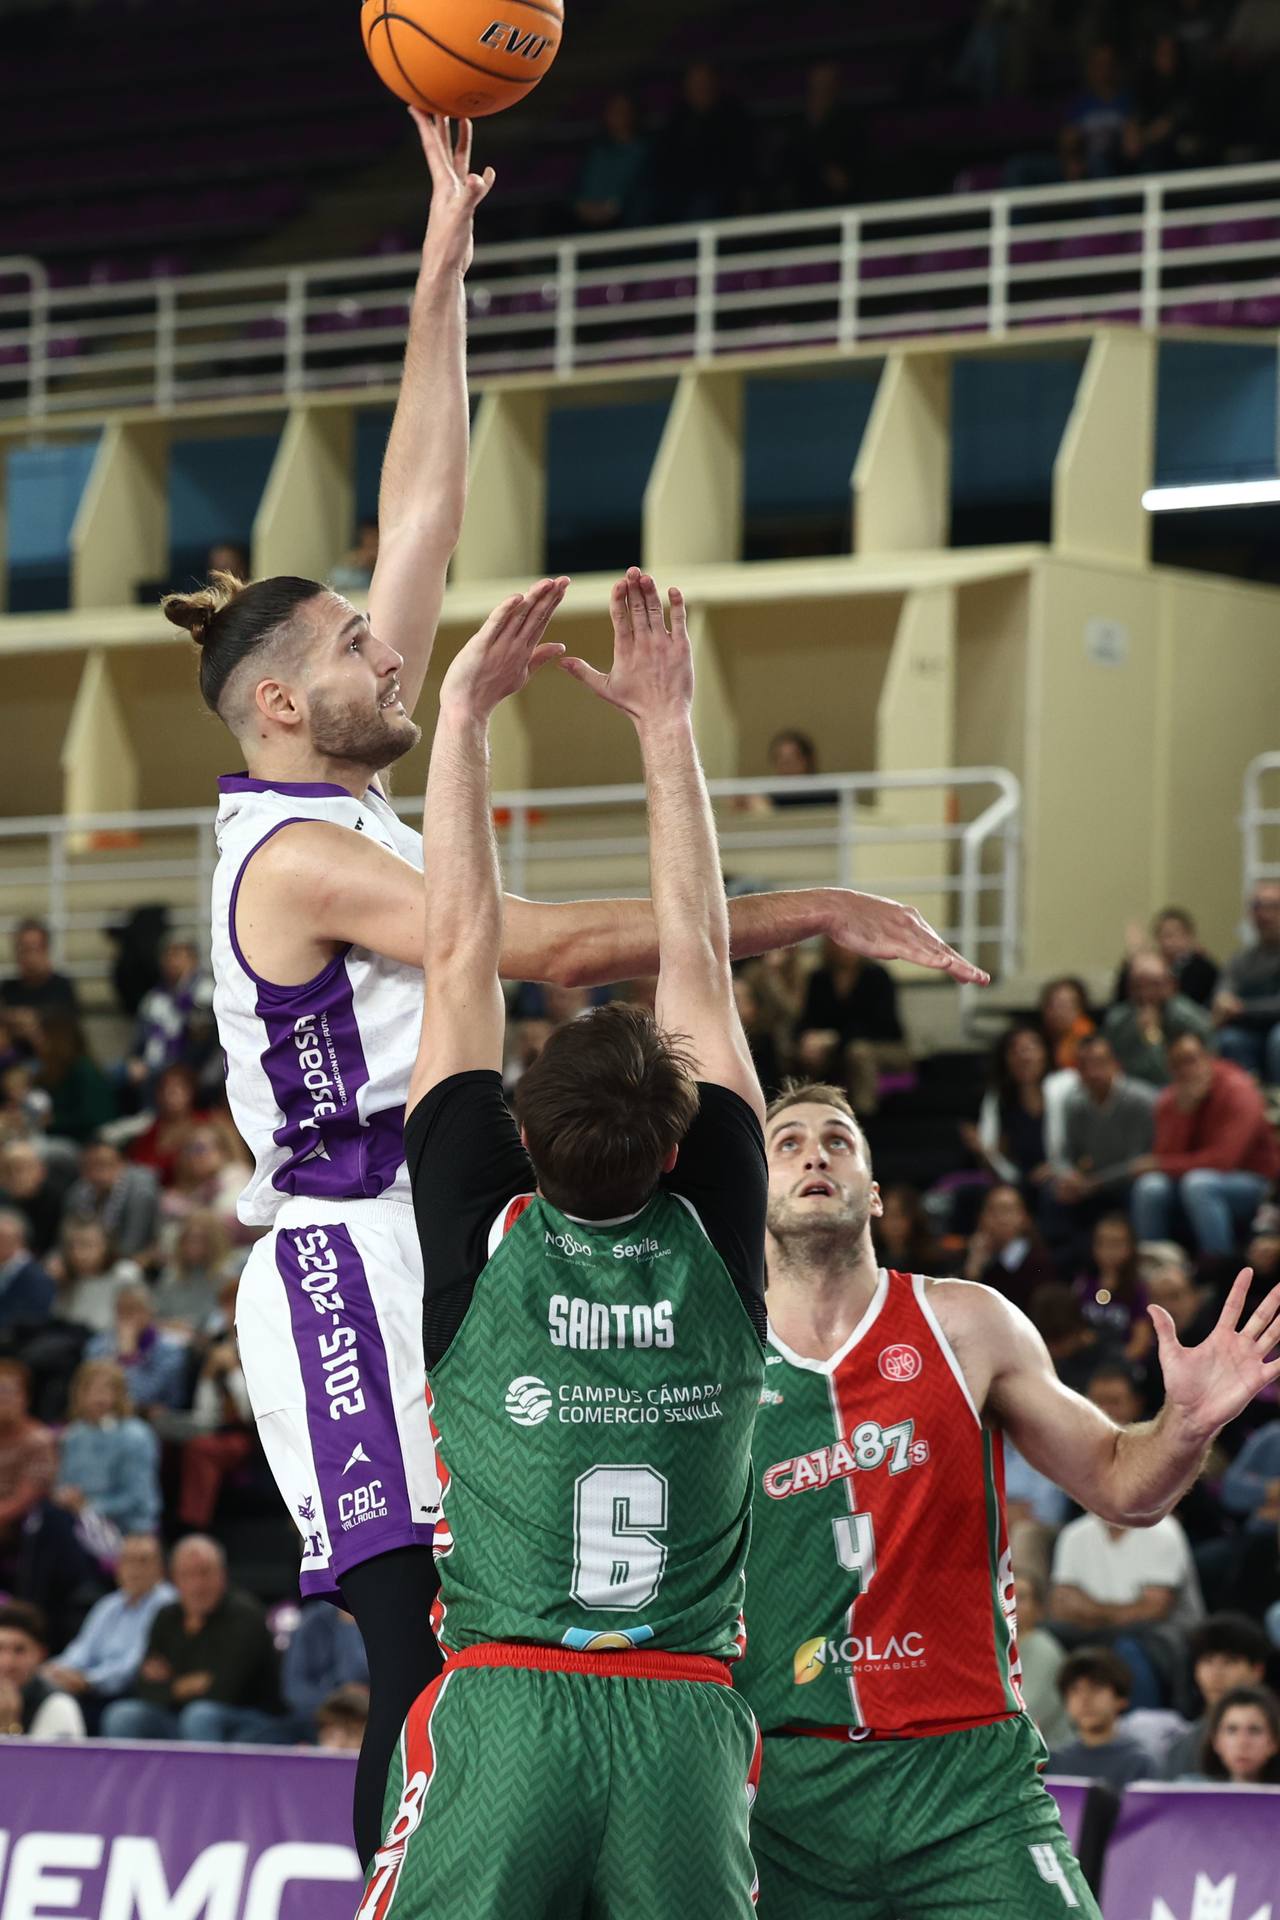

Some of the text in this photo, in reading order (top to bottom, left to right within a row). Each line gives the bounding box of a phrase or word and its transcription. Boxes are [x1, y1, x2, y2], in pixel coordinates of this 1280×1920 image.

[293, 1228, 367, 1421] 2015-2025
[548, 1294, 675, 1350] SANTOS
[558, 1384, 643, 1404] CAMPUS
[558, 1401, 724, 1424] COMERCIO SEVILLA
[338, 1480, 386, 1521] CBC
[341, 1507, 388, 1532] VALLADOLID
[569, 1463, 669, 1612] 6
[832, 1512, 877, 1594] 4
[834, 1659, 928, 1675] RENOVABLES
[0, 1828, 362, 1920] EMC
[1027, 1843, 1080, 1908] 4
